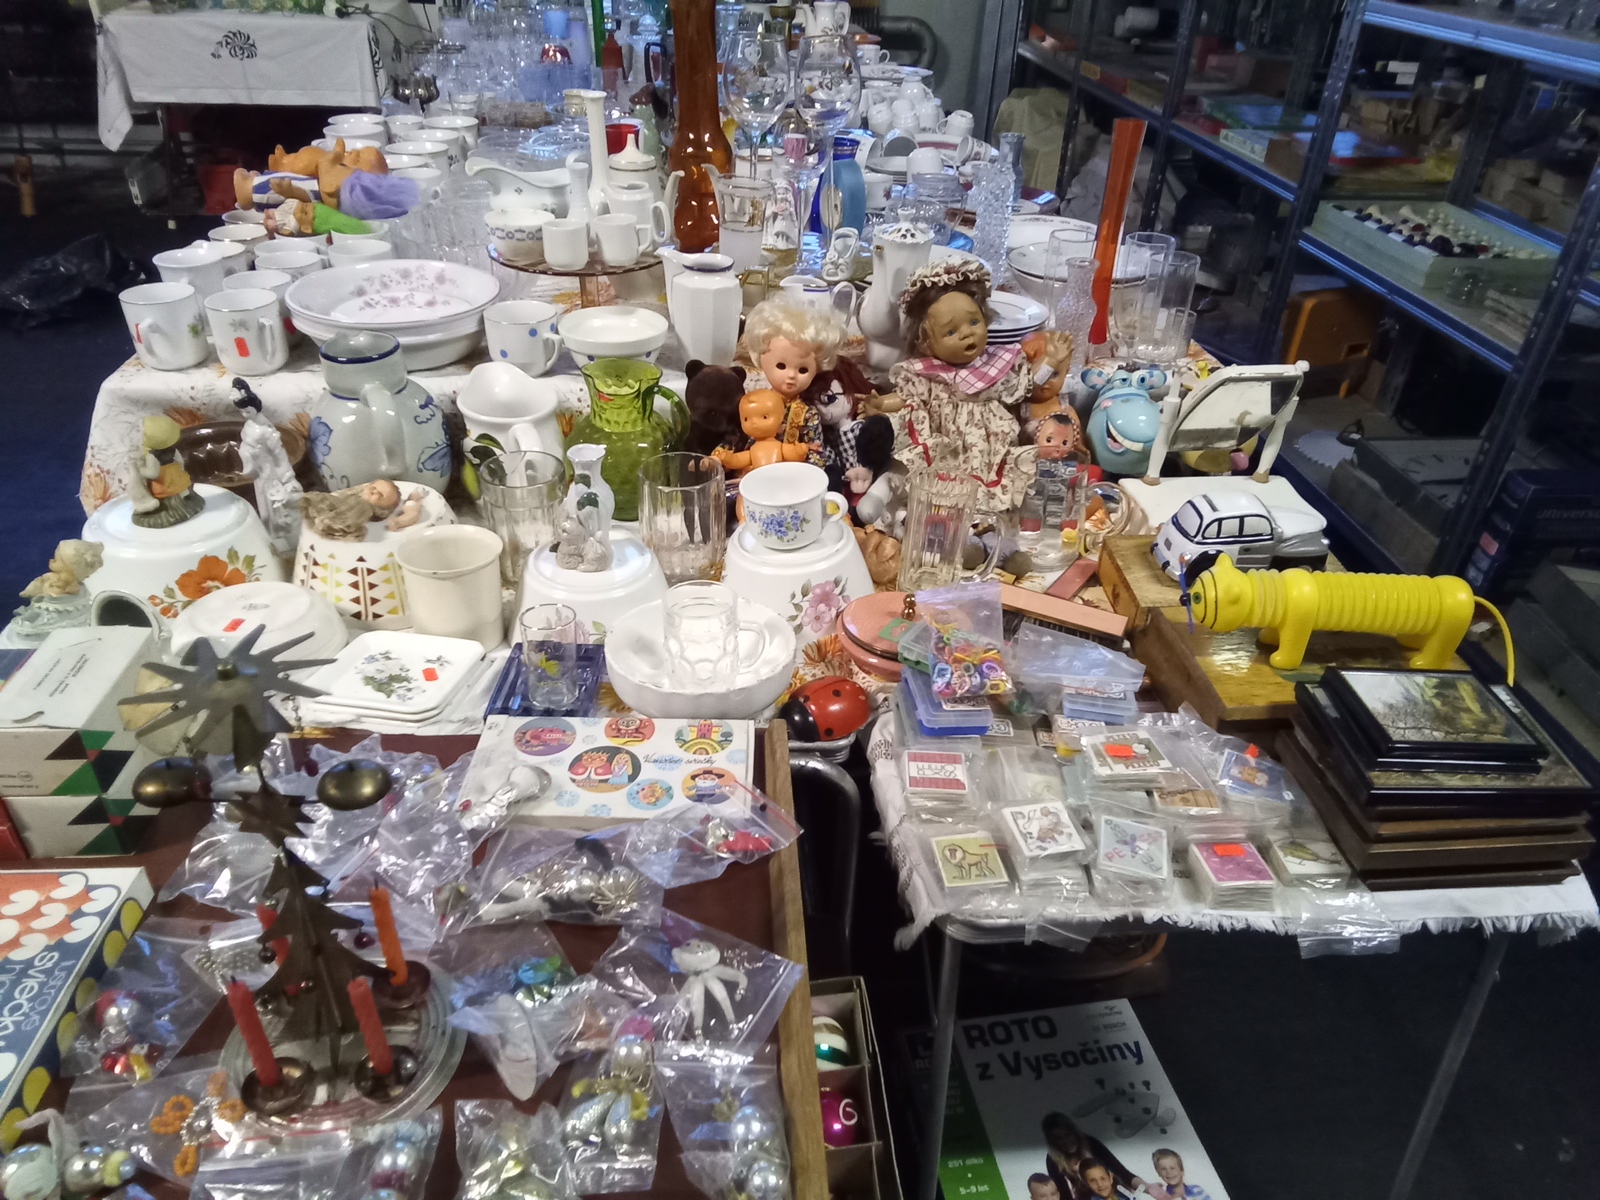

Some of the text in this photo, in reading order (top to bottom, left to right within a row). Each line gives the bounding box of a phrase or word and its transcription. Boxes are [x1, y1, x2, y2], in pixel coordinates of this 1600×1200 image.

[962, 1014, 1058, 1050] ROTO
[975, 1040, 1145, 1082] z Vysočiny
